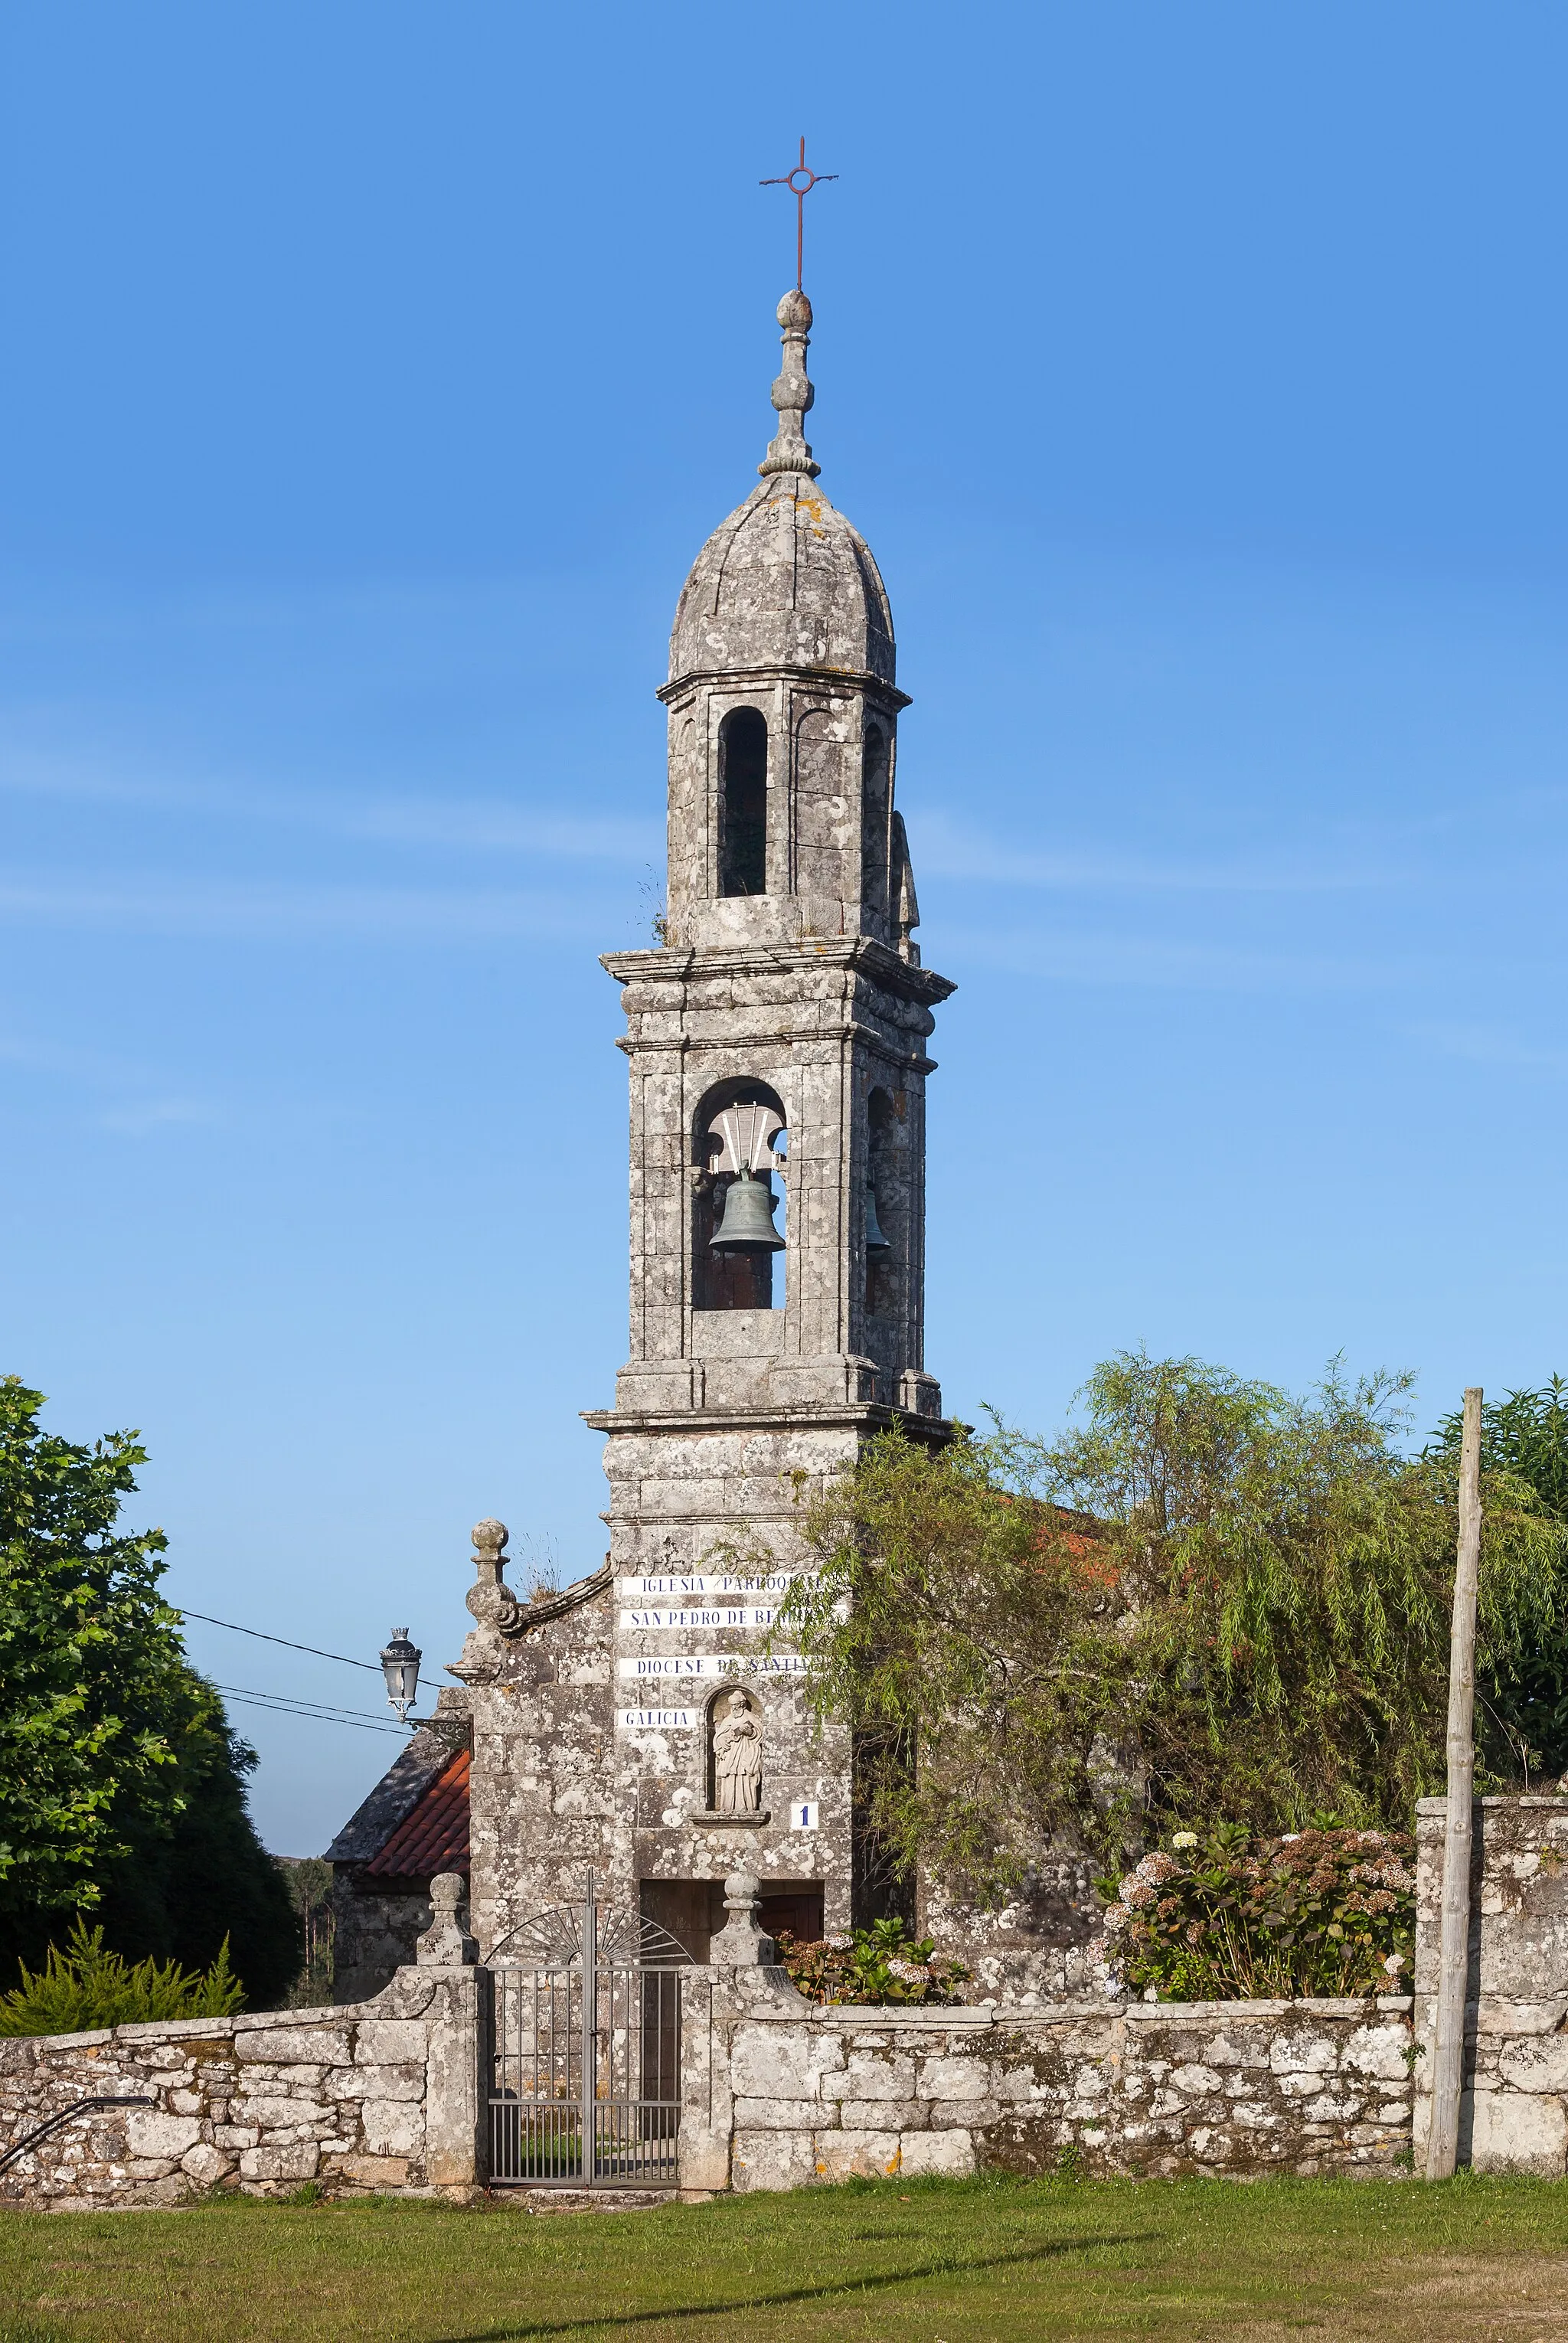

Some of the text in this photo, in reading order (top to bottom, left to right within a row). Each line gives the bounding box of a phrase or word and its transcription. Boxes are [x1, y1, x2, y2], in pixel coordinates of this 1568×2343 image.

[642, 1577, 704, 1592] IGLESIA
[631, 1613, 662, 1626] SAN
[668, 1611, 720, 1625] PEDRO
[727, 1610, 747, 1625] DE
[637, 1659, 704, 1674] DIOCESE
[626, 1711, 690, 1725] GALICIA
[799, 1805, 810, 1826] 1
